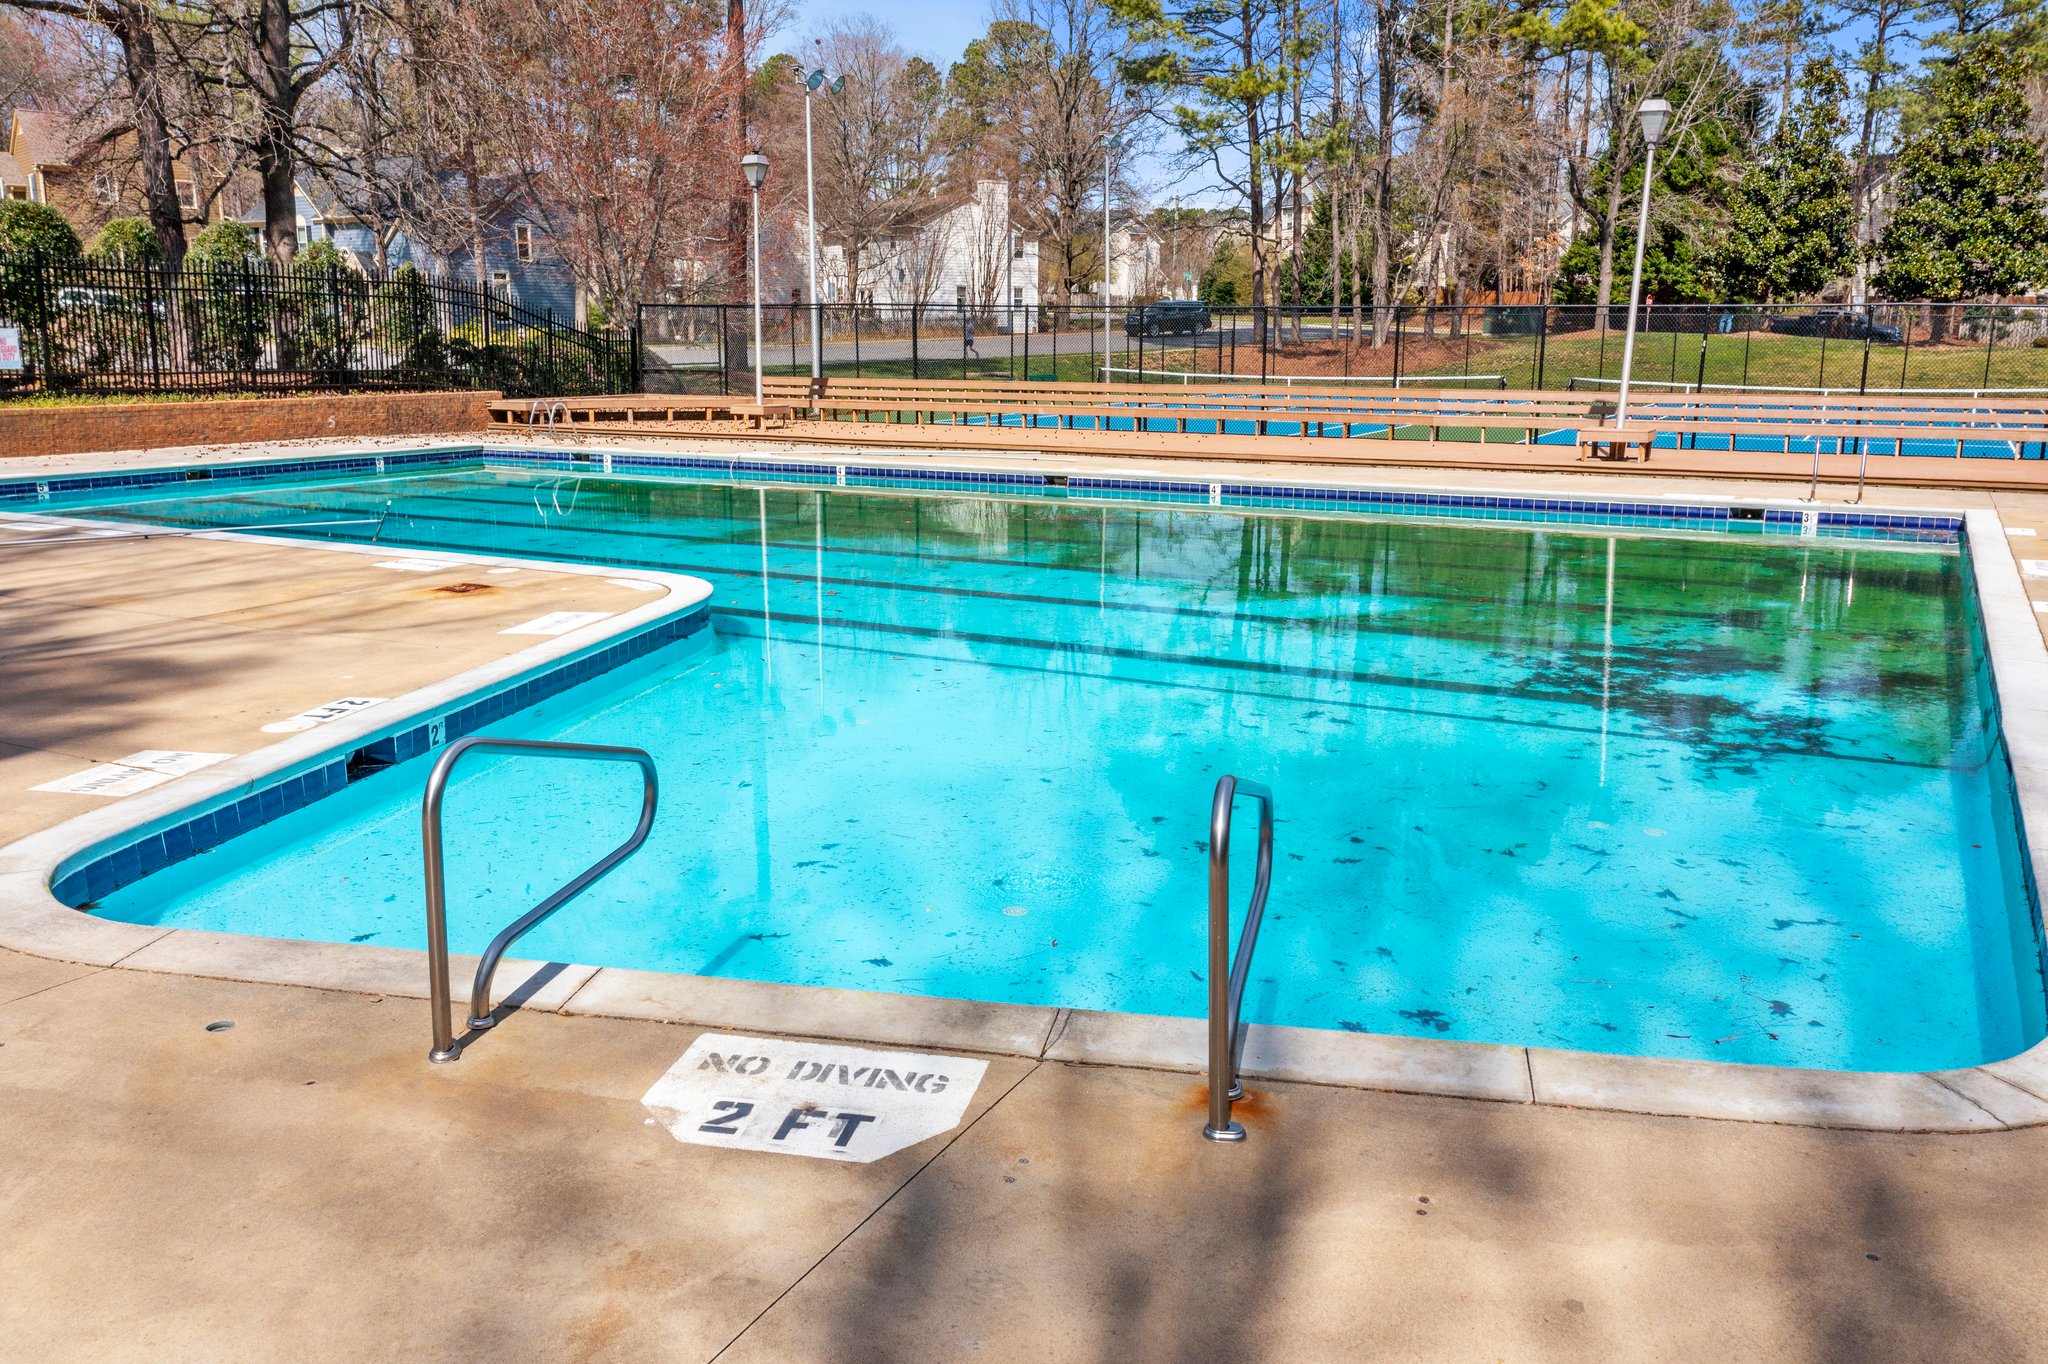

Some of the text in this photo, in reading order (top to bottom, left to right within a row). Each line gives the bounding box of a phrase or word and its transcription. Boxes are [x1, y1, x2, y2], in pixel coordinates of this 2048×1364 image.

[0, 345, 17, 353] GUARD
[1803, 512, 1810, 523] 3
[302, 707, 350, 719] FT
[431, 724, 440, 747] 2
[697, 1052, 950, 1094] NO DIVING
[697, 1100, 877, 1147] 2 FT
